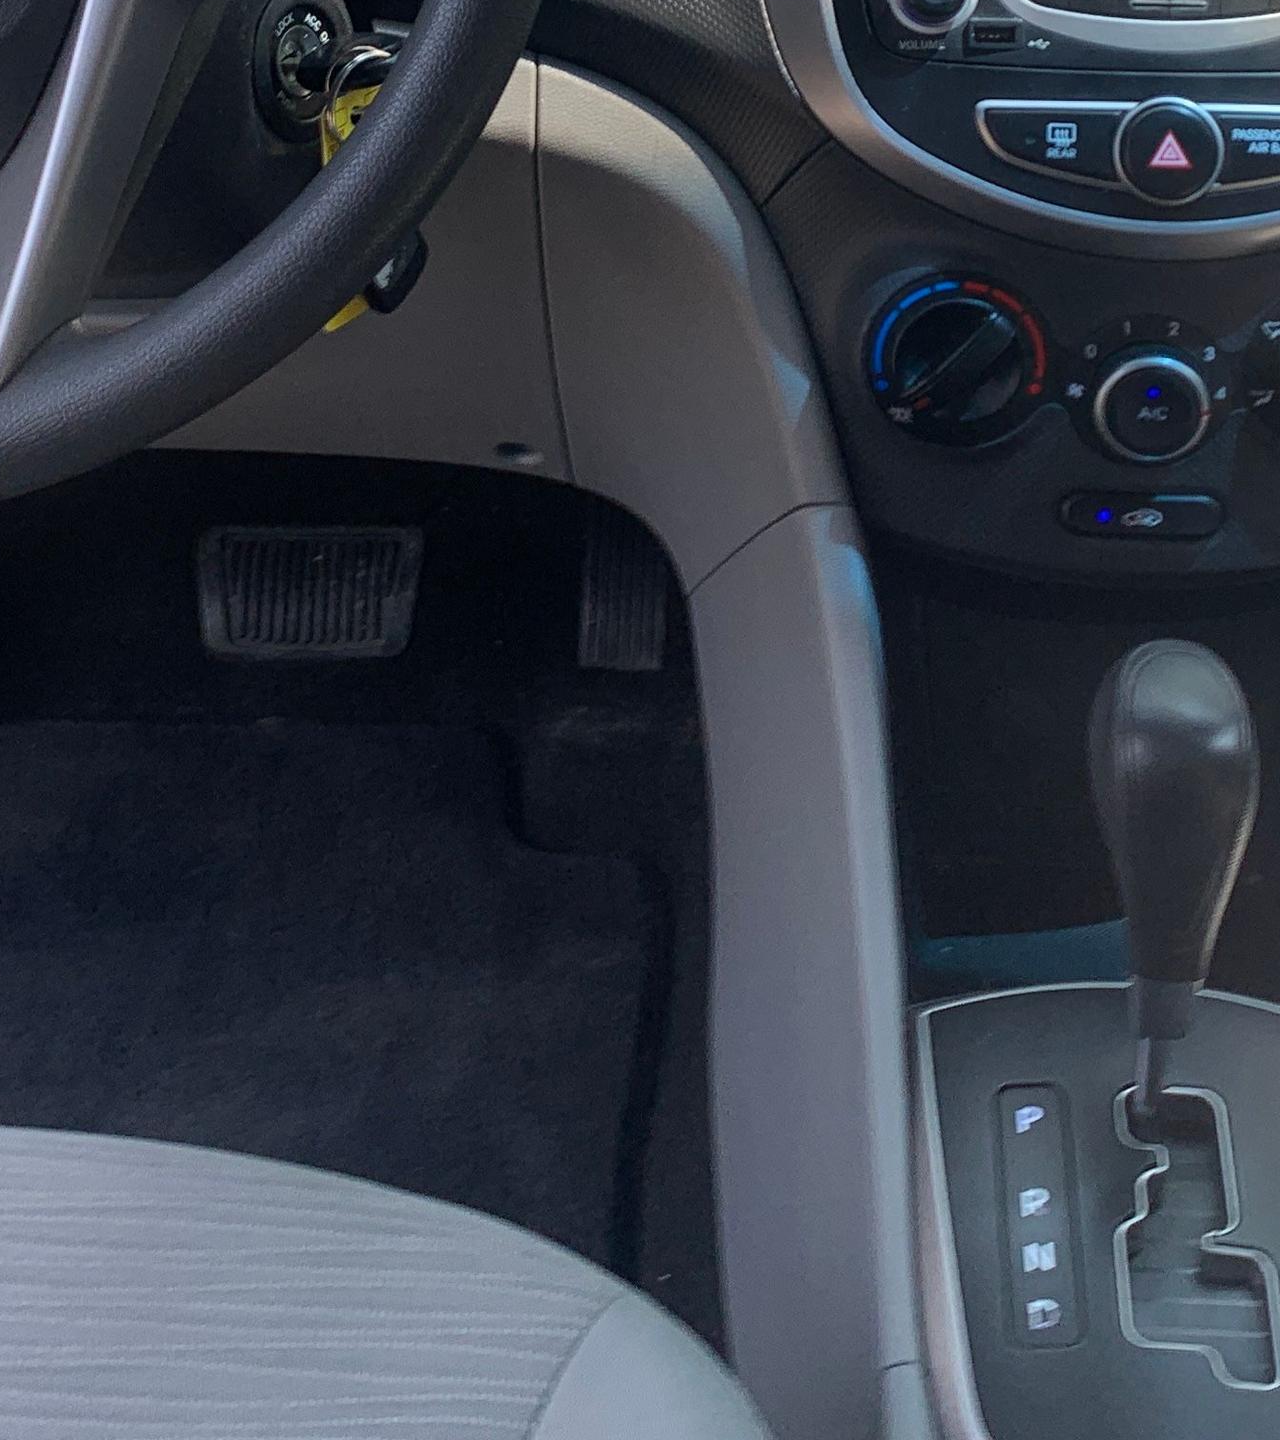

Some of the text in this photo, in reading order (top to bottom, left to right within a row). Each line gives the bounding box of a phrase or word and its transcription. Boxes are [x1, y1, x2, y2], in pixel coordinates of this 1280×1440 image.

[274, 12, 295, 38] LOCK
[898, 40, 946, 50] VOLUME
[1046, 148, 1078, 158] REAR
[1247, 141, 1270, 154] AIR
[1168, 322, 1180, 337] 2
[1084, 344, 1098, 360] 0
[1202, 346, 1216, 361] 3
[1215, 386, 1227, 400] 4
[1014, 1105, 1046, 1134] P
[1026, 1298, 1062, 1330] D
